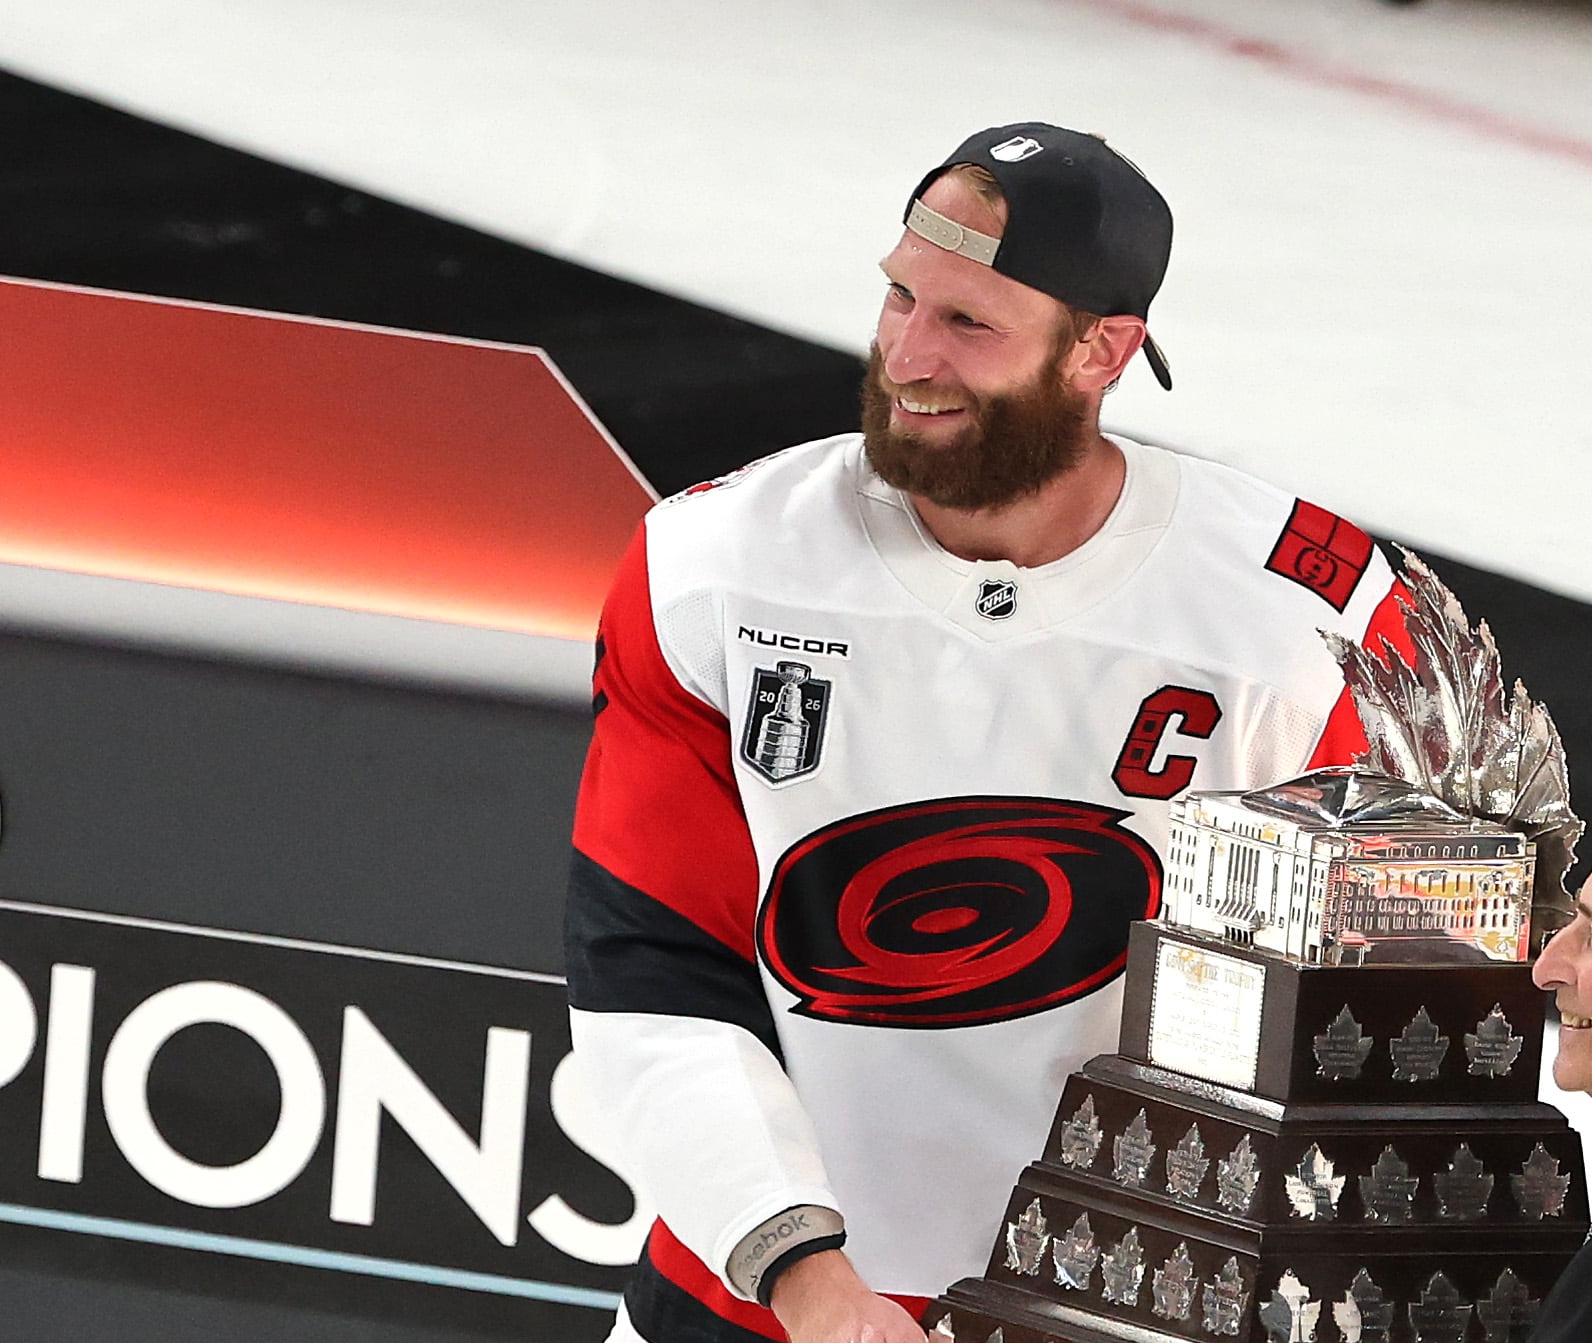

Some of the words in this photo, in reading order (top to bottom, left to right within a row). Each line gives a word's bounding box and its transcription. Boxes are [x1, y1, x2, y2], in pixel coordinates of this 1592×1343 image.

[982, 589, 1011, 612] NHL
[738, 626, 849, 657] NUCOR
[759, 690, 776, 704] 20
[804, 698, 822, 711] 26
[1111, 684, 1223, 800] C
